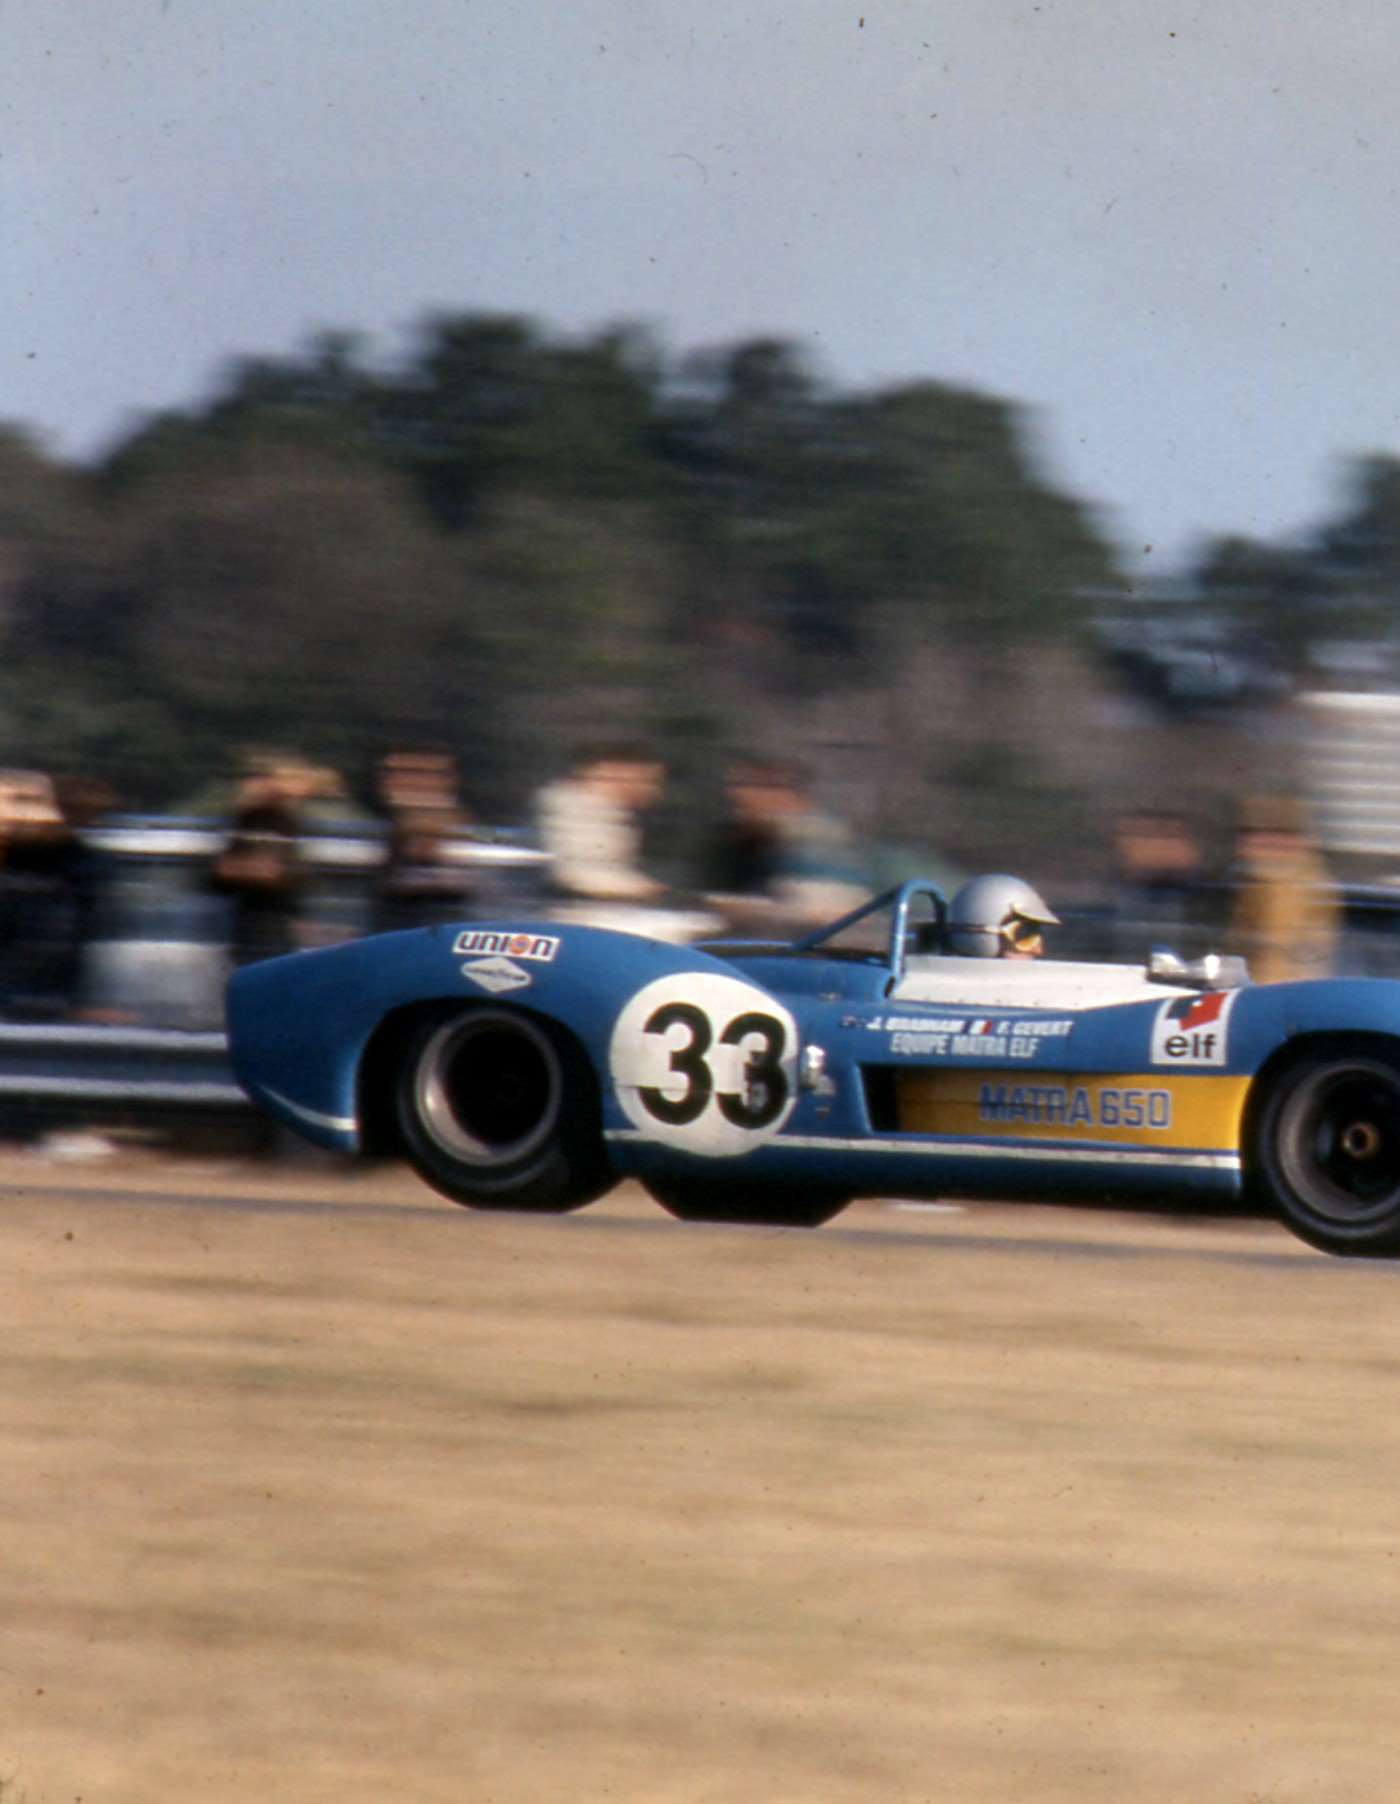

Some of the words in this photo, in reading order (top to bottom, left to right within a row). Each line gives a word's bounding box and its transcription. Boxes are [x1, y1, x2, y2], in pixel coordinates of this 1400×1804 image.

[1009, 1037, 1040, 1059] ELF
[1164, 1033, 1217, 1059] elf
[638, 1002, 788, 1130] 33
[978, 1081, 1093, 1127] MATRA
[1098, 1088, 1173, 1130] 650
